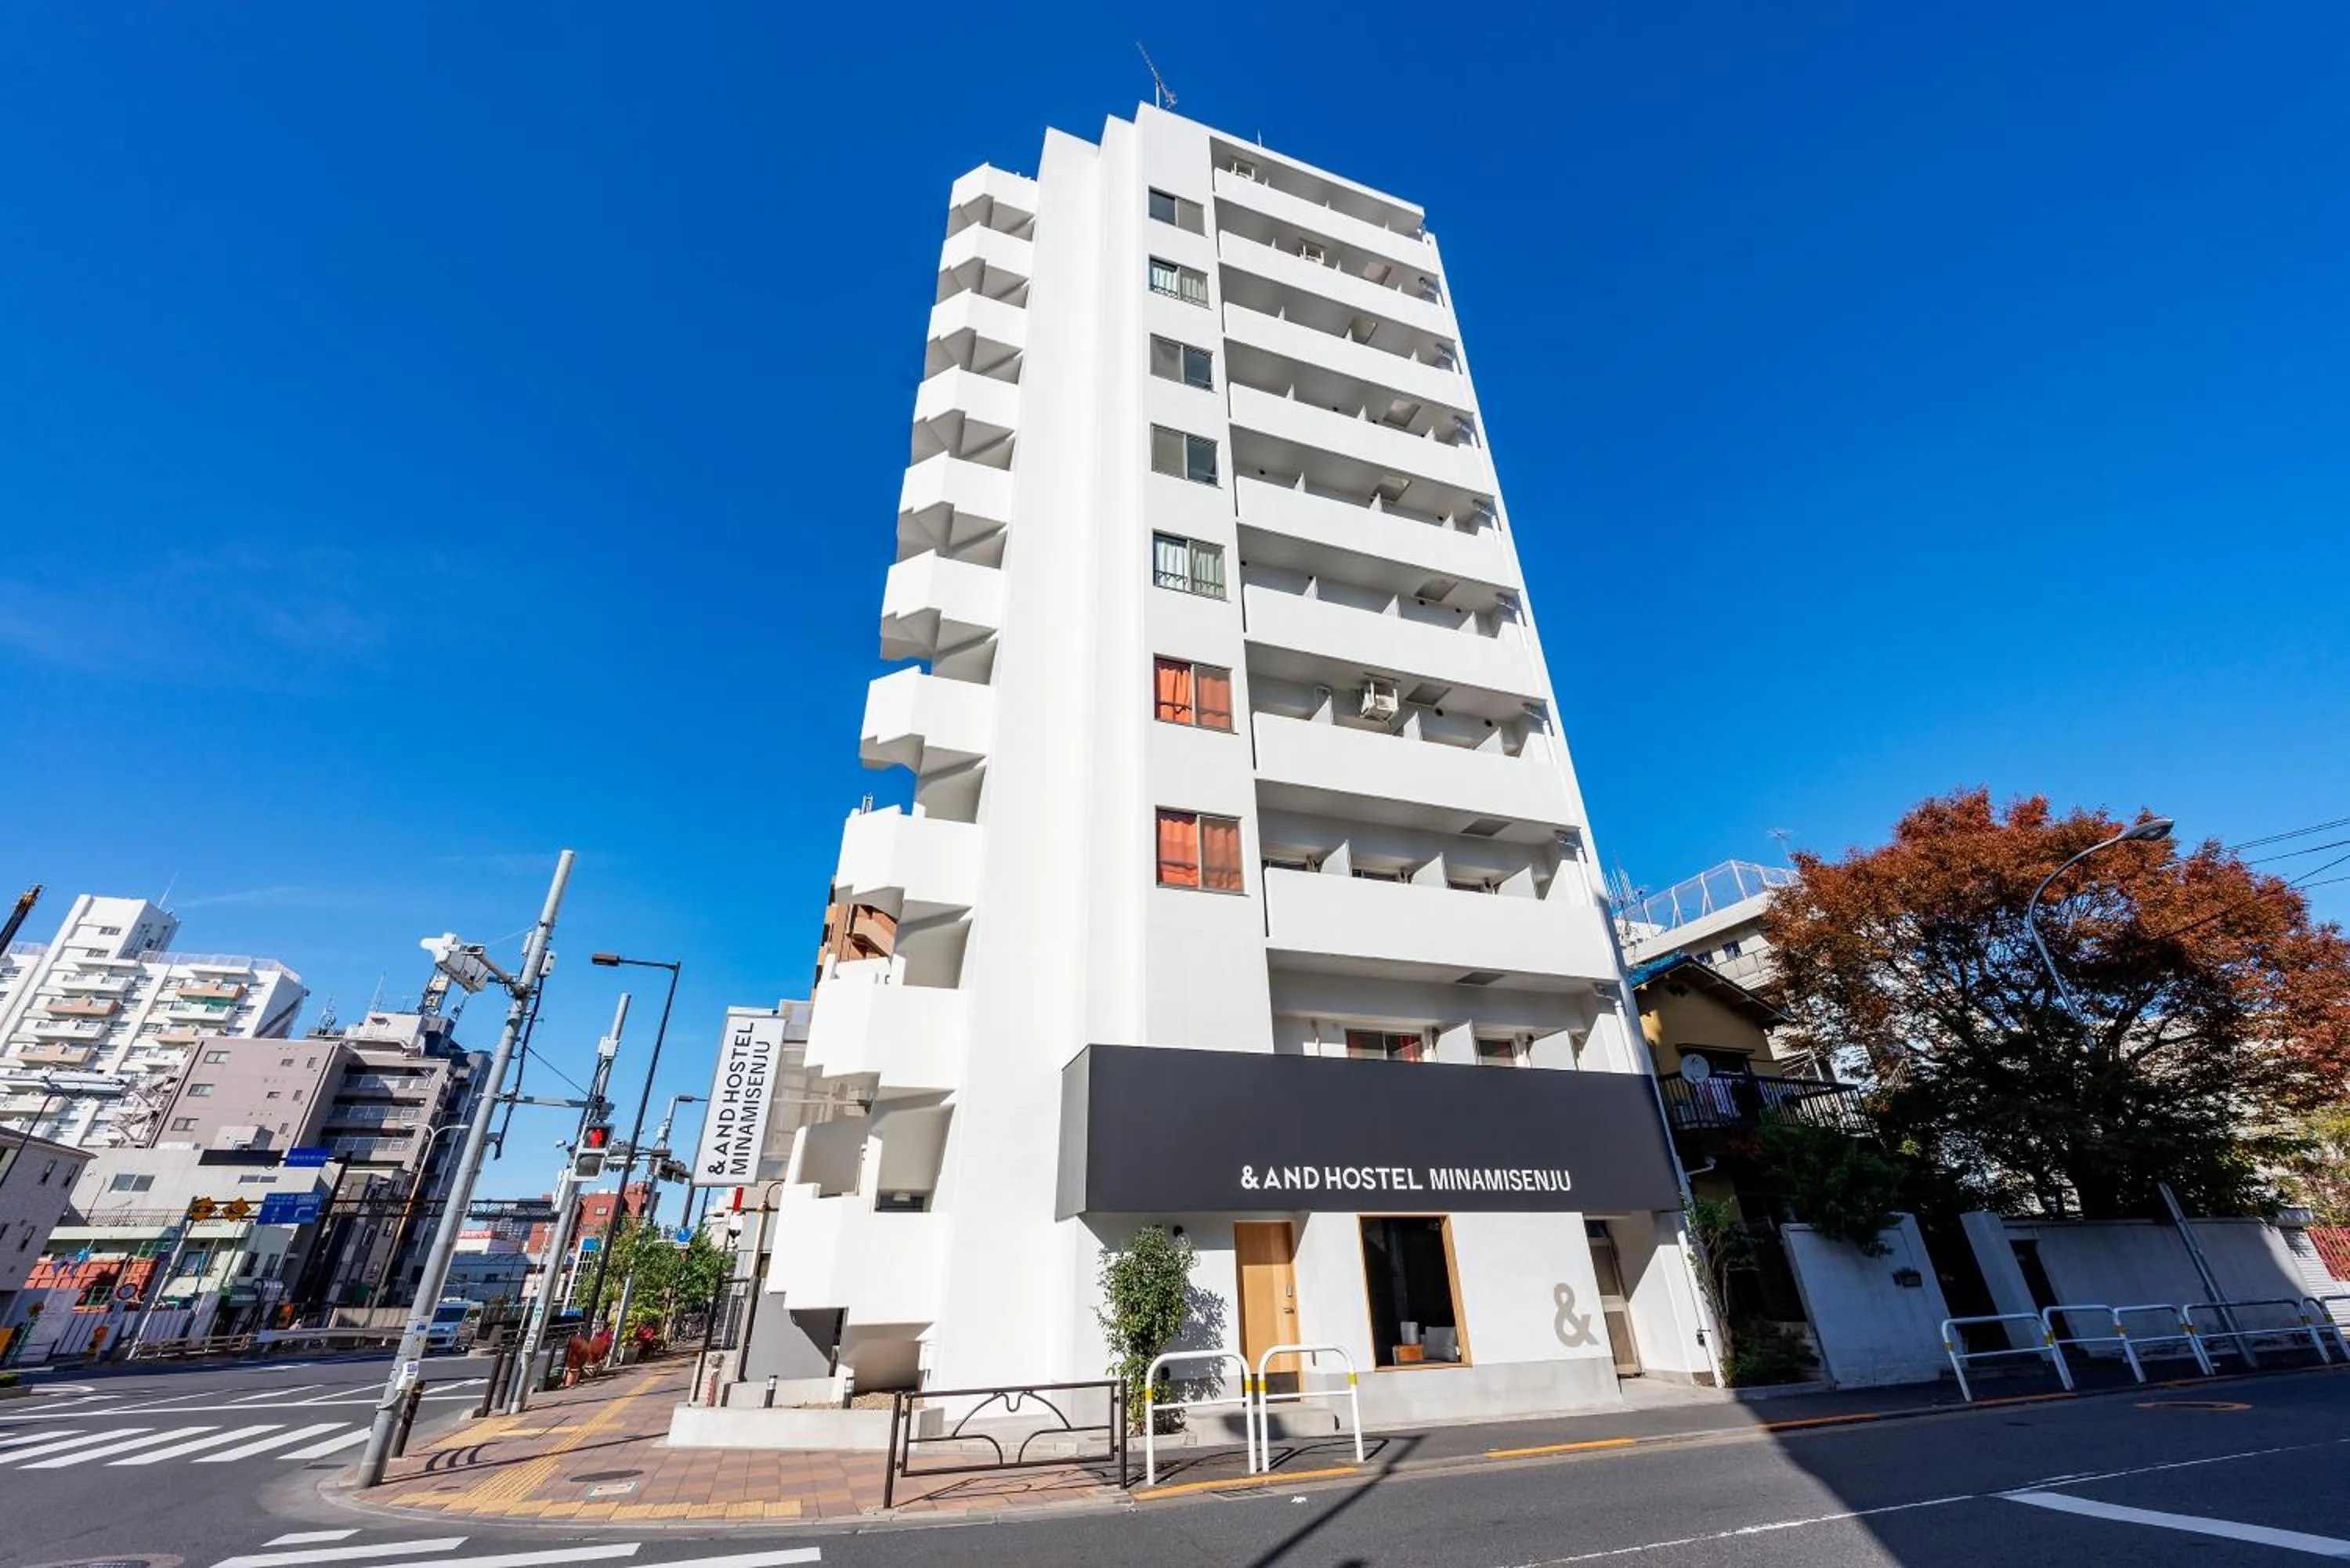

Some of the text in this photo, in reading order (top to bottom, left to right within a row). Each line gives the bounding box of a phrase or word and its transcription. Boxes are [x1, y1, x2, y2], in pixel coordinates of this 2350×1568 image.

[722, 1022, 754, 1104] HOSTEL
[729, 1041, 771, 1175] MINAMISENJU
[1325, 1166, 1423, 1190] HOSTEL
[1429, 1168, 1571, 1191] MINAMISENJU
[1553, 1282, 1600, 1348] &
